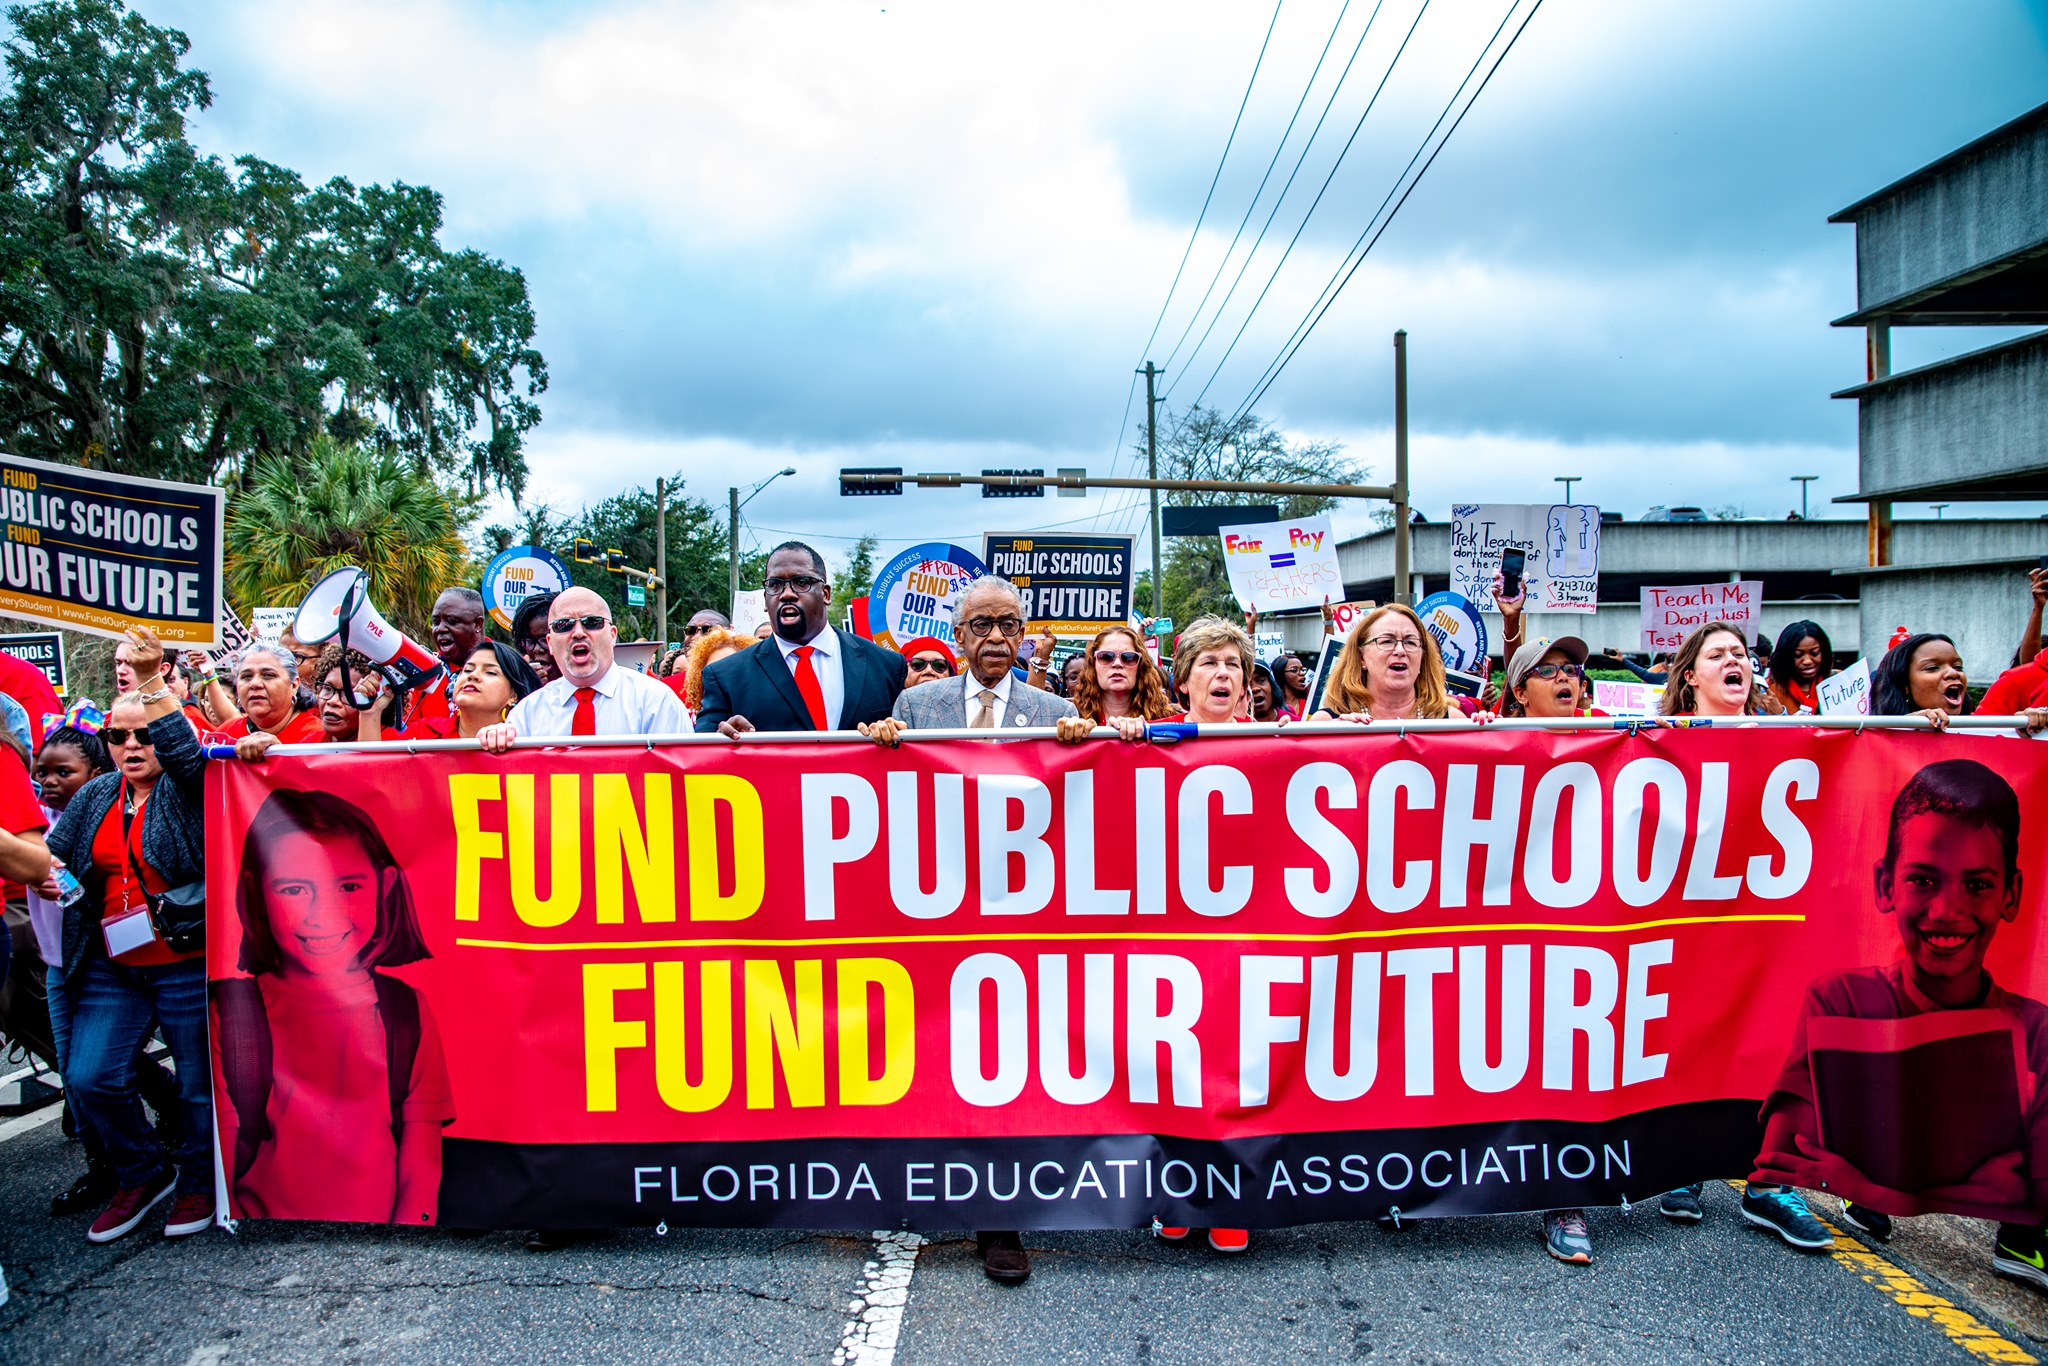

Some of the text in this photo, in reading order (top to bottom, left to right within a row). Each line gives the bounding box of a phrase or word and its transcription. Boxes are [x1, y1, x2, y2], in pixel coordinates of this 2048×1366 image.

[3, 468, 37, 490] FUND
[0, 487, 198, 550] UBLIC SCHOOLS
[7, 524, 40, 545] FUND
[1012, 540, 1033, 551] FUND
[1225, 528, 1325, 555] Fair Pay
[1481, 522, 1533, 549] Teachers
[993, 553, 1048, 575] PUBLIC
[1050, 553, 1123, 575] SCHOOLS
[1471, 558, 1489, 569] the
[1528, 549, 1541, 561] of
[505, 566, 534, 581] FUND
[876, 551, 921, 600] STUDENT SUCCESS
[918, 558, 973, 579] #POLK
[1239, 560, 1338, 590] TEACHERS
[1455, 565, 1470, 582] So
[58, 552, 199, 617] FUTURE
[504, 580, 526, 594] OUR
[907, 571, 949, 597] FUND
[1464, 584, 1488, 598] VPK
[503, 594, 526, 607] FUT
[902, 592, 936, 617] OUR
[1038, 587, 1122, 618] FUTURE
[1557, 591, 1589, 602] 3 hours
[1648, 584, 1750, 608] Teach Me
[1433, 608, 1460, 635] FUND
[1664, 606, 1751, 625] Don't Just
[367, 620, 384, 638] PYLE
[1645, 630, 1684, 647] Test
[1597, 683, 1646, 709] WE
[1821, 677, 1866, 711] Future
[449, 757, 1821, 928] FUND PUBLIC SCHOOLS
[582, 938, 1674, 1113] FUND OUR FUTURE
[634, 1139, 1632, 1204] FLORIDA EDUCATION ASSOCIATION
